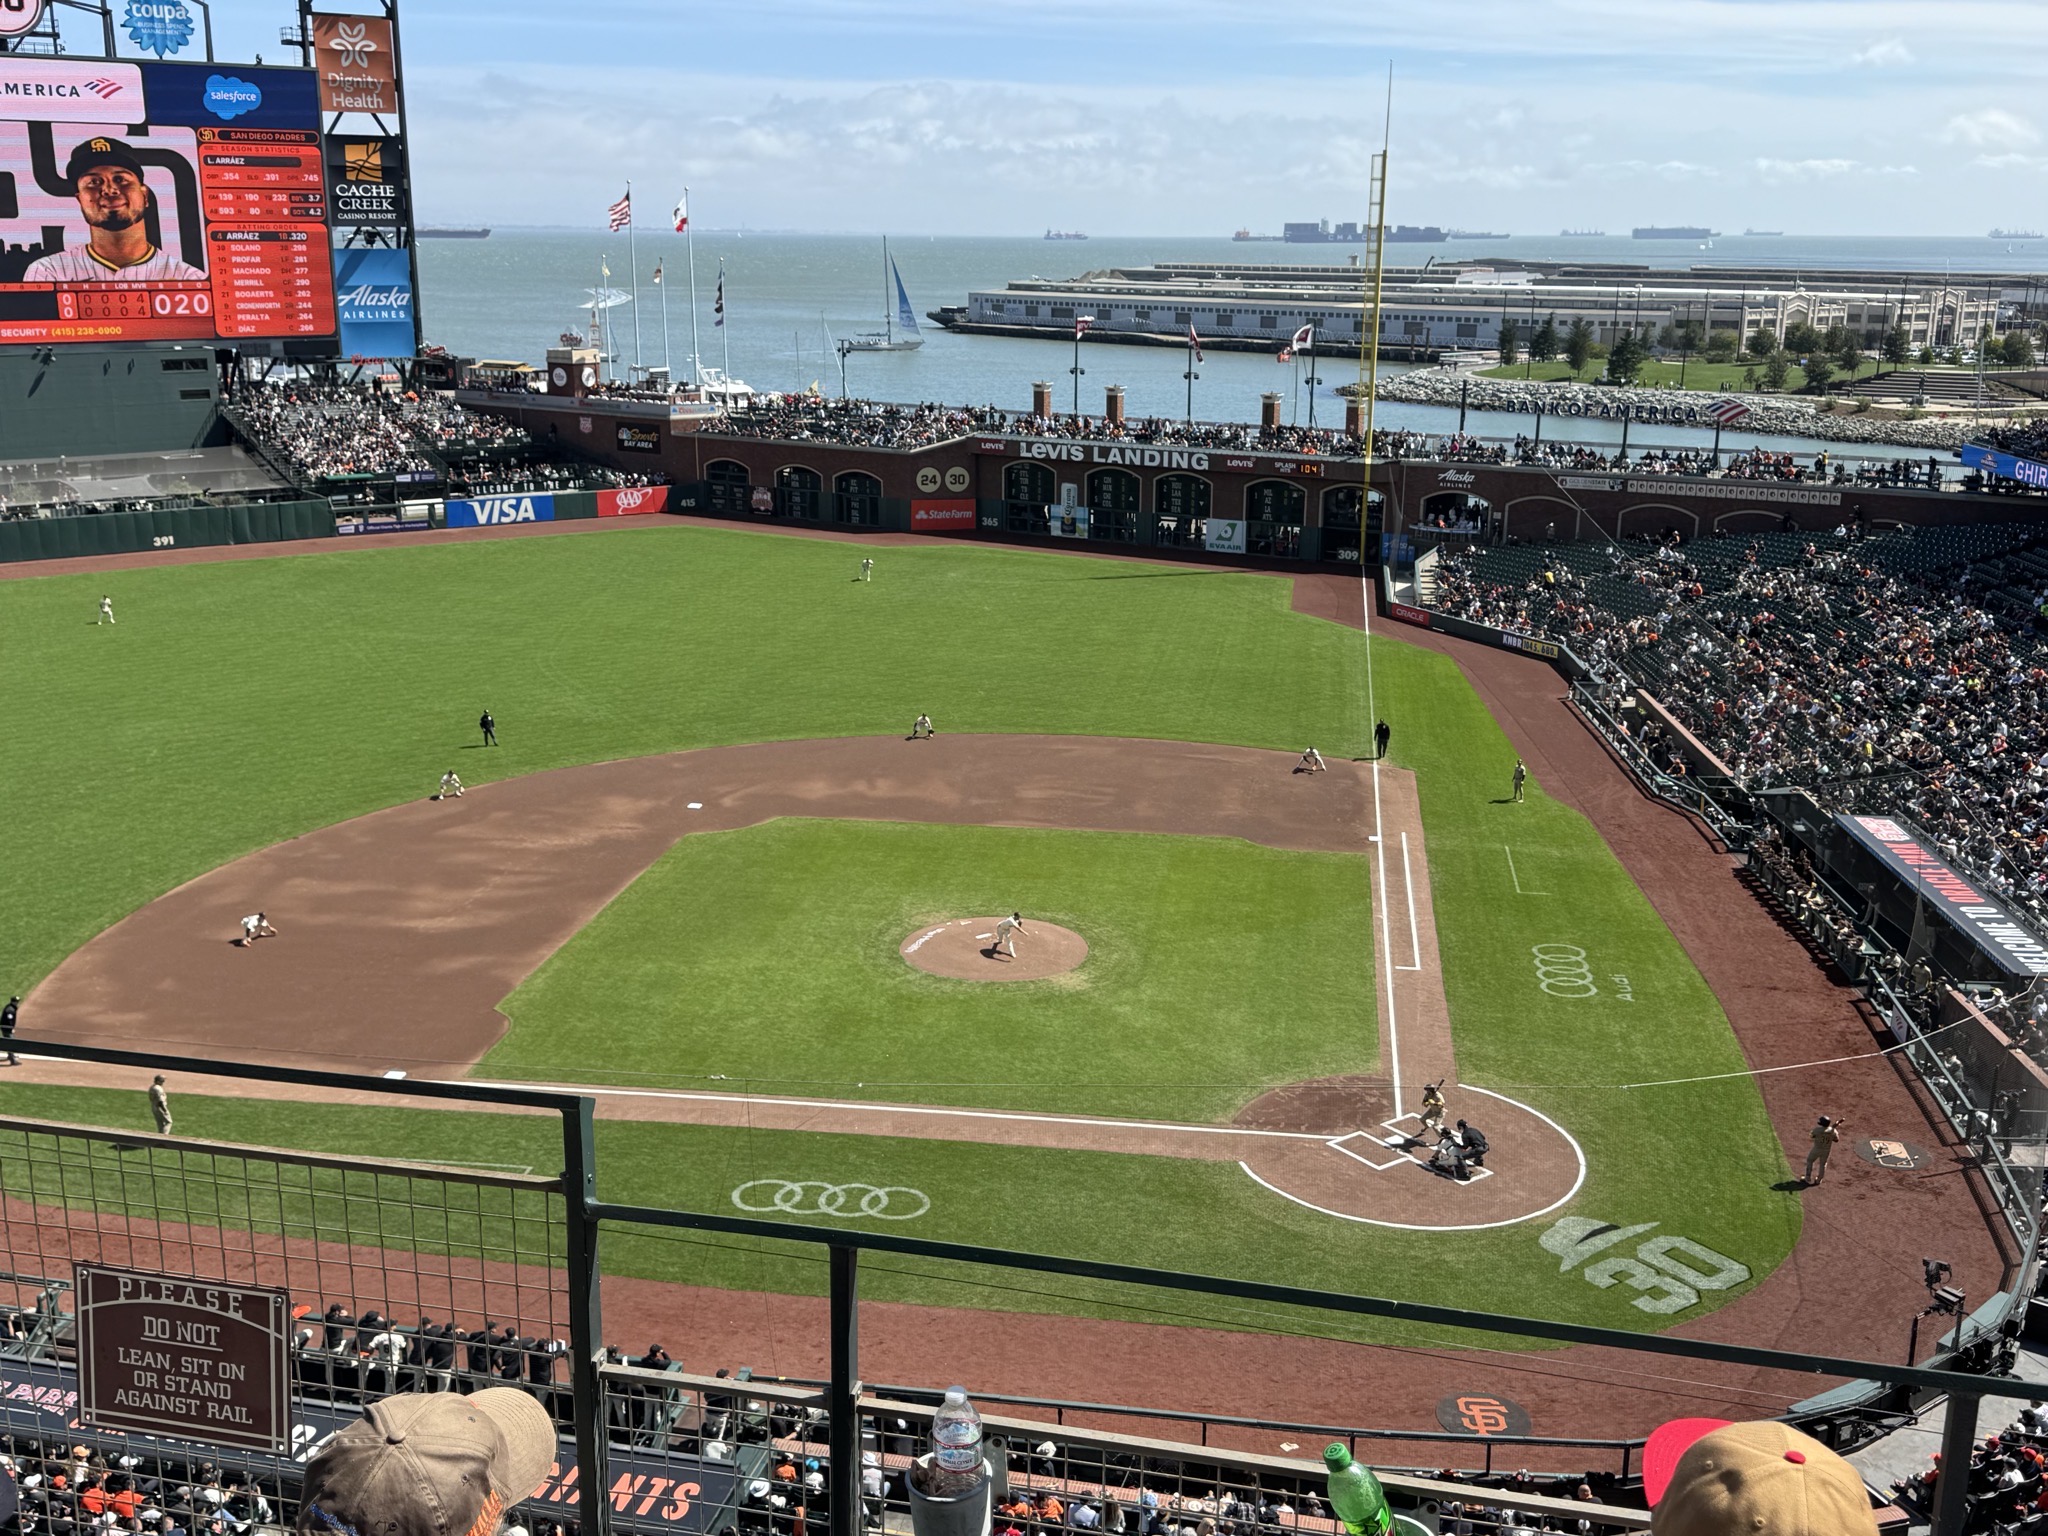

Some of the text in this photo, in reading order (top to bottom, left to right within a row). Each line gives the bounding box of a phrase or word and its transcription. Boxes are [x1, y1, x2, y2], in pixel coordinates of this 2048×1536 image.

[132, 4, 186, 23] coupa
[328, 73, 384, 92] Dignity
[0, 82, 80, 97] MERICA
[210, 91, 256, 102] salesforce
[332, 93, 384, 108] Health
[230, 132, 247, 140] SAN
[275, 133, 306, 141] PADRES
[216, 156, 245, 164] ARRÁEZ
[302, 174, 318, 182] .745
[336, 184, 395, 197] CACHE
[338, 198, 394, 210] CREEK
[226, 231, 260, 240] ARRÁEZ
[63, 294, 144, 305] 0 0 0 0 4
[338, 284, 410, 308] Alaska
[64, 306, 146, 318] 0 0 0 0 4
[344, 310, 405, 319] AIRLINES
[0, 328, 47, 337] SECURITY
[52, 327, 75, 336] (415)
[1506, 400, 1698, 421] BANK OF AMERICA
[630, 429, 658, 442] Sports
[1094, 446, 1209, 470] LANDING
[1300, 465, 1317, 473] 104
[1438, 469, 1476, 482] Alaska
[524, 482, 534, 491] TO
[568, 480, 585, 488] 415
[921, 475, 938, 486] 24
[950, 474, 965, 485] 30
[620, 492, 640, 506] AAA
[681, 498, 696, 507] 415
[467, 498, 535, 524] VISA
[982, 517, 998, 526] 365
[153, 535, 174, 547] 391
[1338, 550, 1358, 560] 309
[1396, 608, 1424, 622] ORACLE
[1502, 634, 1554, 656] KNBR 680
[1883, 842, 1940, 865] PARK
[1913, 868, 1985, 903] ORACLE
[1959, 906, 2004, 919] TO
[1608, 974, 1635, 1002] Audi
[1584, 1235, 1753, 1314] 30
[118, 1277, 242, 1318] PLEASE
[143, 1316, 220, 1346] DO NOT
[118, 1347, 246, 1381] LEAN, SIT ON
[134, 1371, 231, 1400] OR STAND
[114, 1389, 252, 1424] AGAINST RAIL
[1457, 1397, 1509, 1436] SF
[941, 1457, 956, 1466] CRYSTAL
